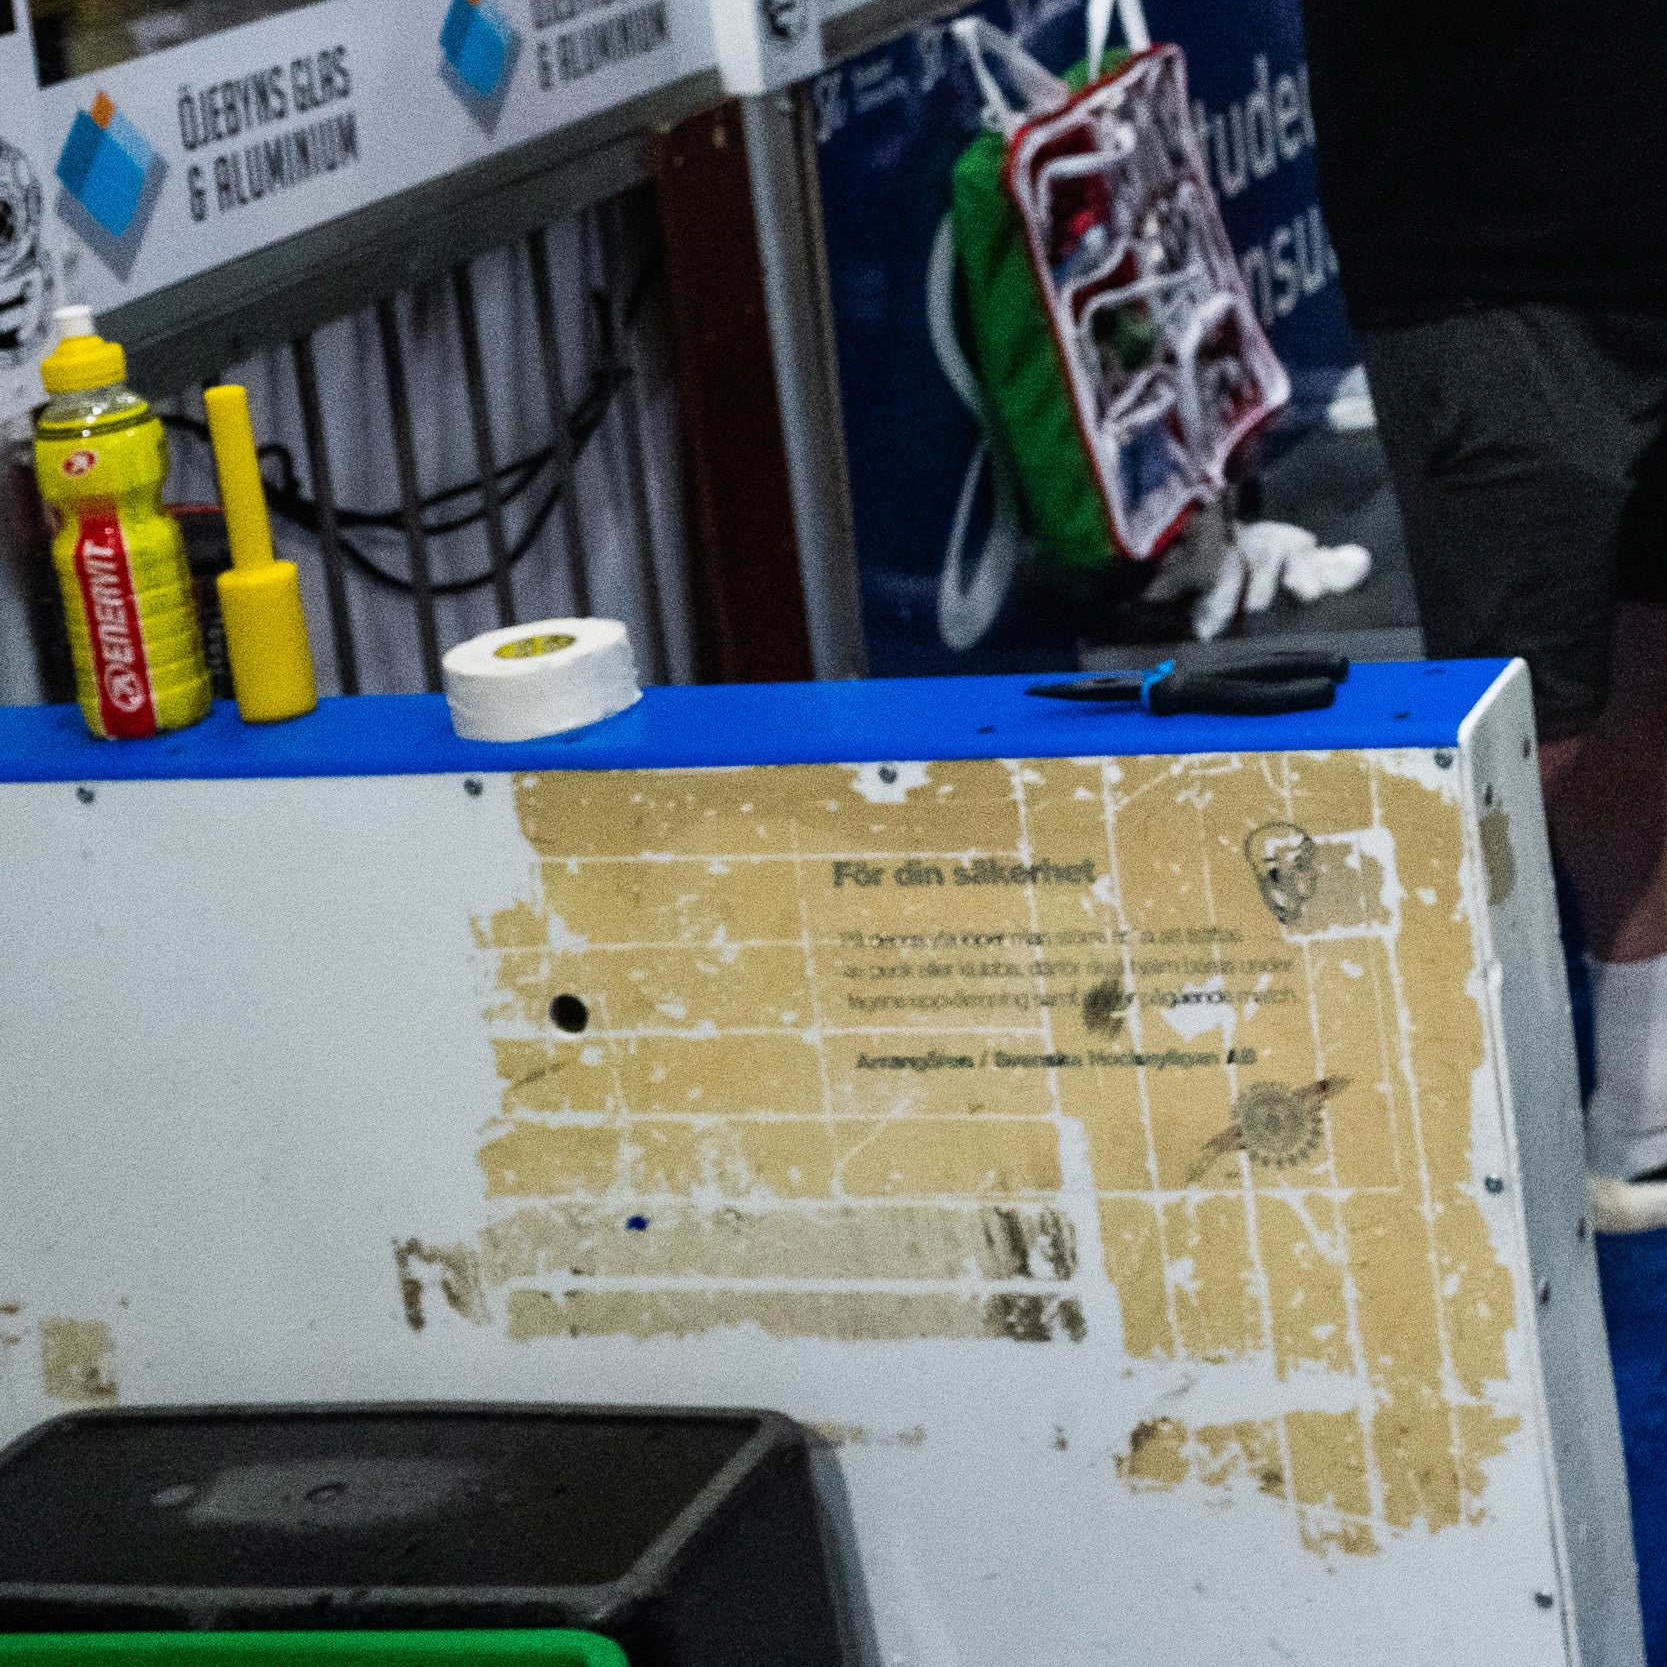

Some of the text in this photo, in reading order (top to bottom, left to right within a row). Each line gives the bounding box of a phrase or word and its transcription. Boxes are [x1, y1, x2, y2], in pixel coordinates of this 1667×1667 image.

[177, 44, 350, 152] ÖJEBYNS GLAS
[215, 110, 358, 214] ALUMINIUM
[83, 539, 138, 666] ENERVIT
[832, 857, 1097, 887] För din säkerhet
